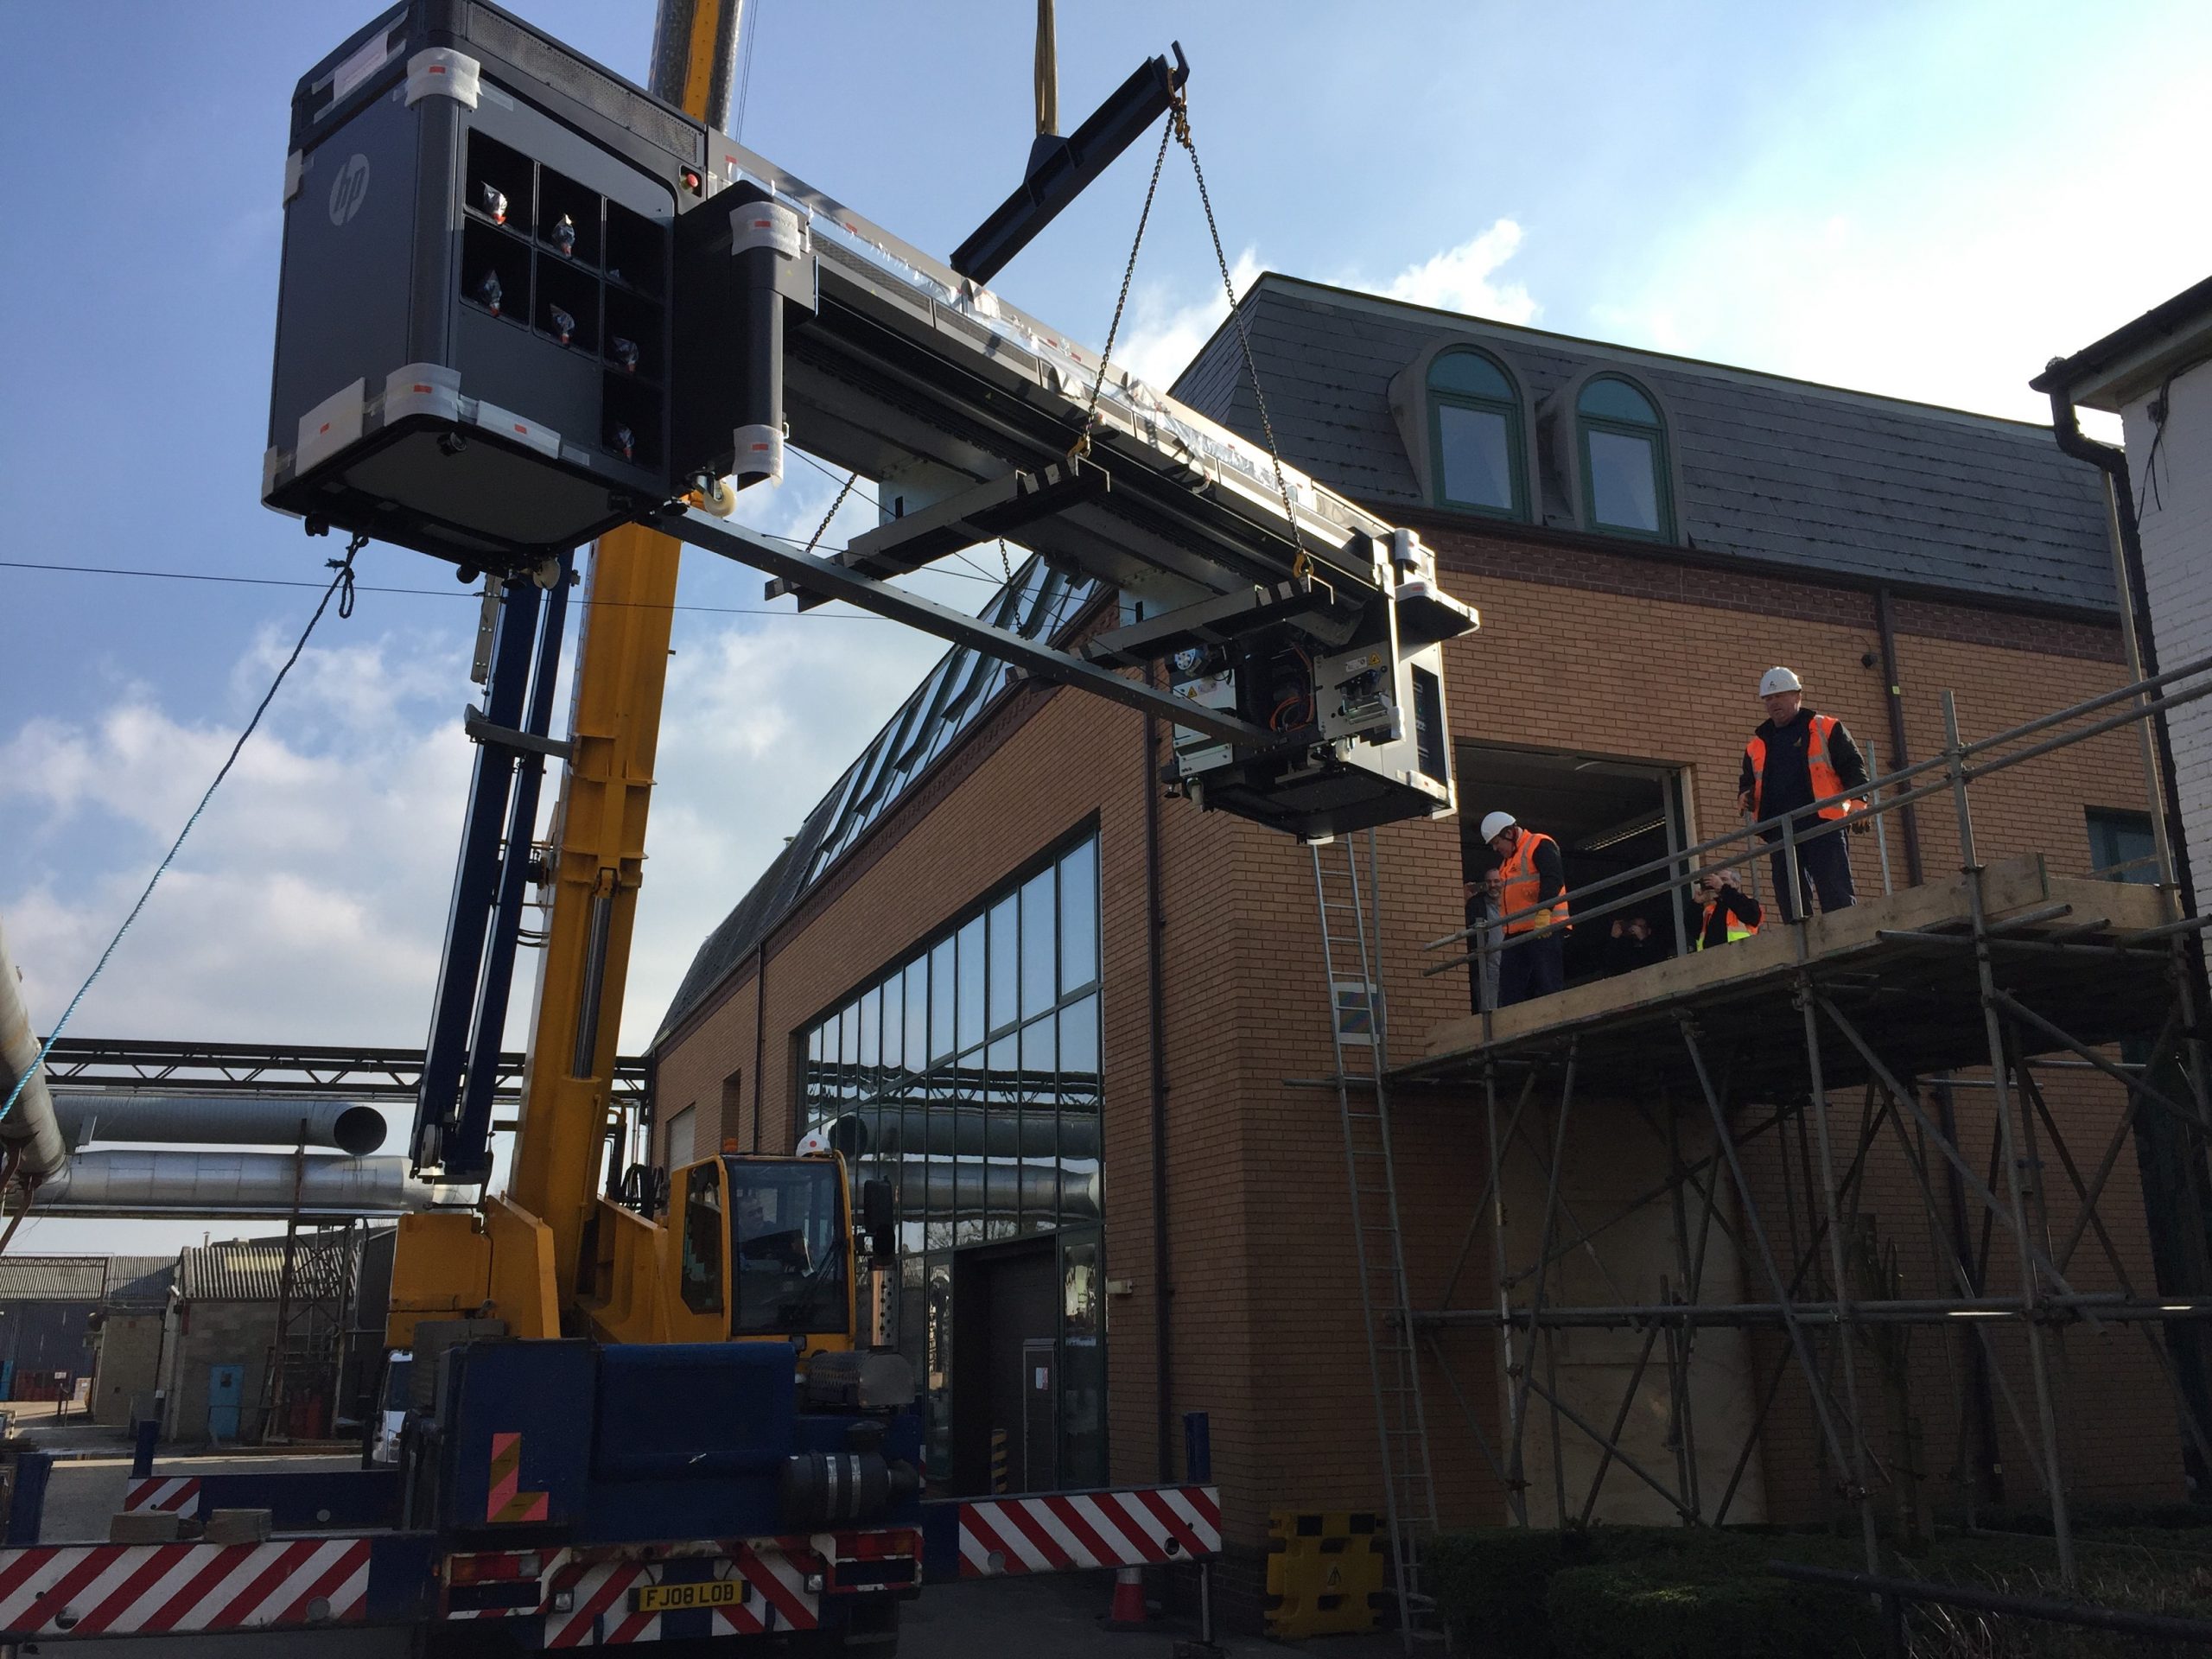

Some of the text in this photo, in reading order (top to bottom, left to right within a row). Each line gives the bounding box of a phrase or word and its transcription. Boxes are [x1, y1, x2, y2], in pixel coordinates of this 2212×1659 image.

[329, 154, 369, 226] hp
[646, 1584, 734, 1607] FJ08 LOB
